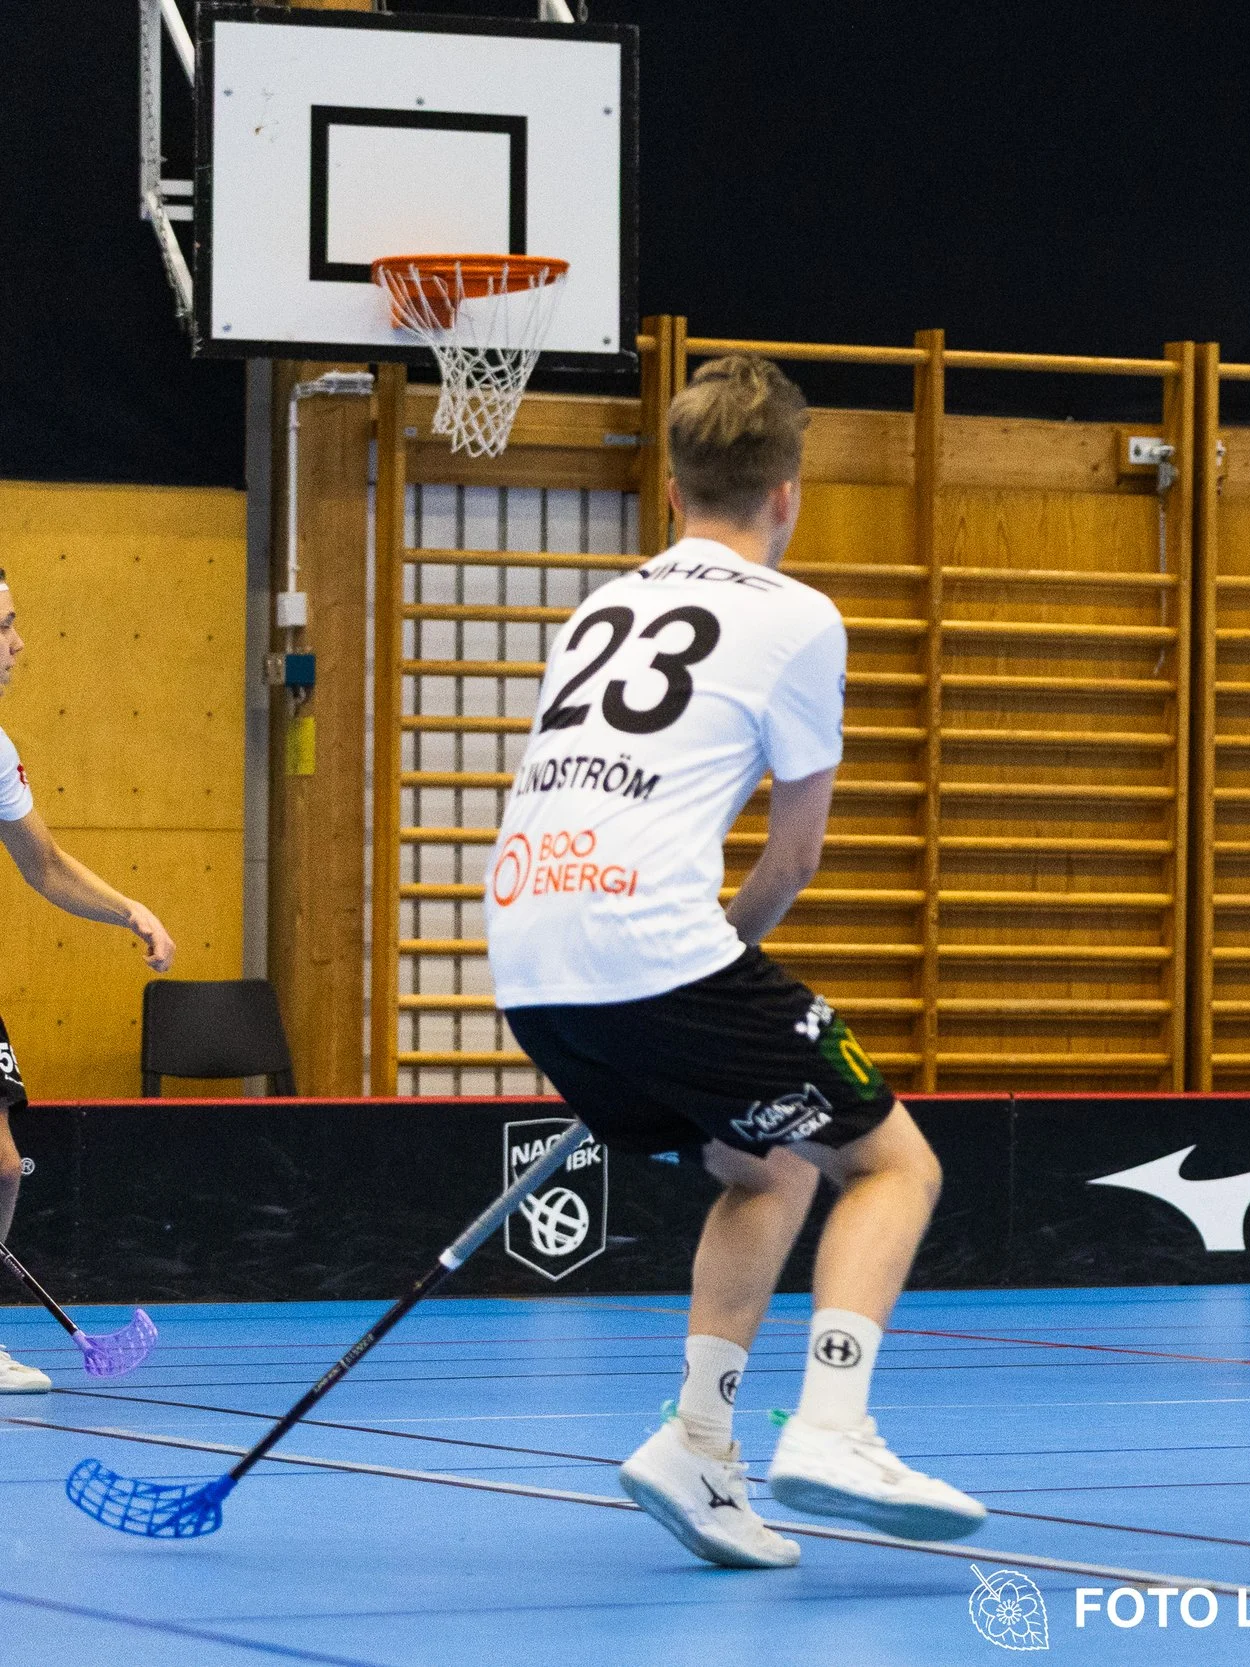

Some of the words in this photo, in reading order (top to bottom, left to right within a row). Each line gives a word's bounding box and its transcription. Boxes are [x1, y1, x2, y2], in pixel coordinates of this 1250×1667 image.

[540, 605, 721, 734] 23
[539, 829, 597, 861] BOO
[533, 863, 638, 897] ENERGI
[566, 1144, 601, 1172] IBK
